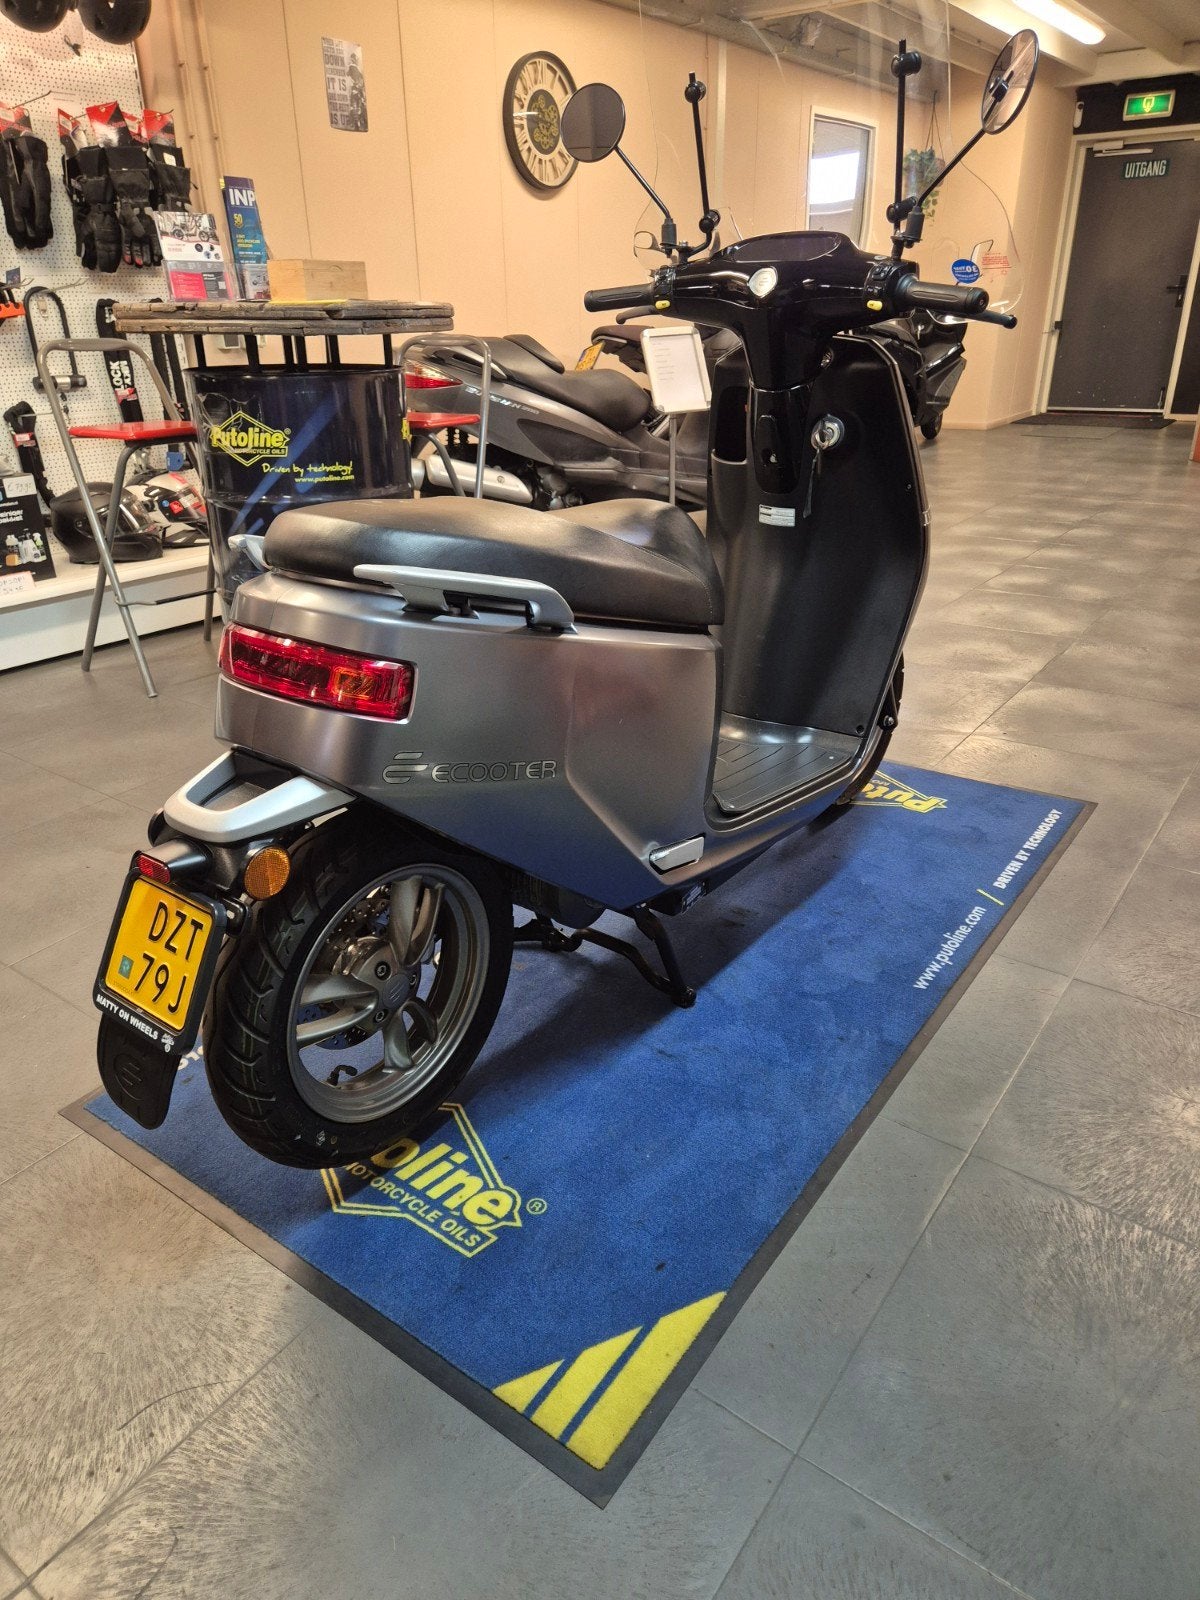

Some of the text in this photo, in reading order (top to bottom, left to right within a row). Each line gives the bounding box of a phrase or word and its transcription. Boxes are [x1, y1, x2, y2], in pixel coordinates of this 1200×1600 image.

[324, 53, 345, 67] DOWN
[327, 77, 347, 91] IT IS
[1125, 160, 1167, 178] UITGANG
[210, 425, 285, 448] Putoline
[261, 462, 291, 473] Driven
[292, 463, 304, 476] by
[294, 474, 355, 483] www.putoline.com
[431, 760, 557, 783] ECOOTER
[992, 809, 1063, 889] DRIVEN BY TECHNOLOGY
[148, 901, 204, 961] DZT
[913, 906, 988, 990] www.putoline.com
[134, 952, 188, 1014] 79J
[96, 994, 159, 1040] MATTY ON WHEELS
[370, 1138, 513, 1225] oline
[440, 1219, 481, 1247] OILS
